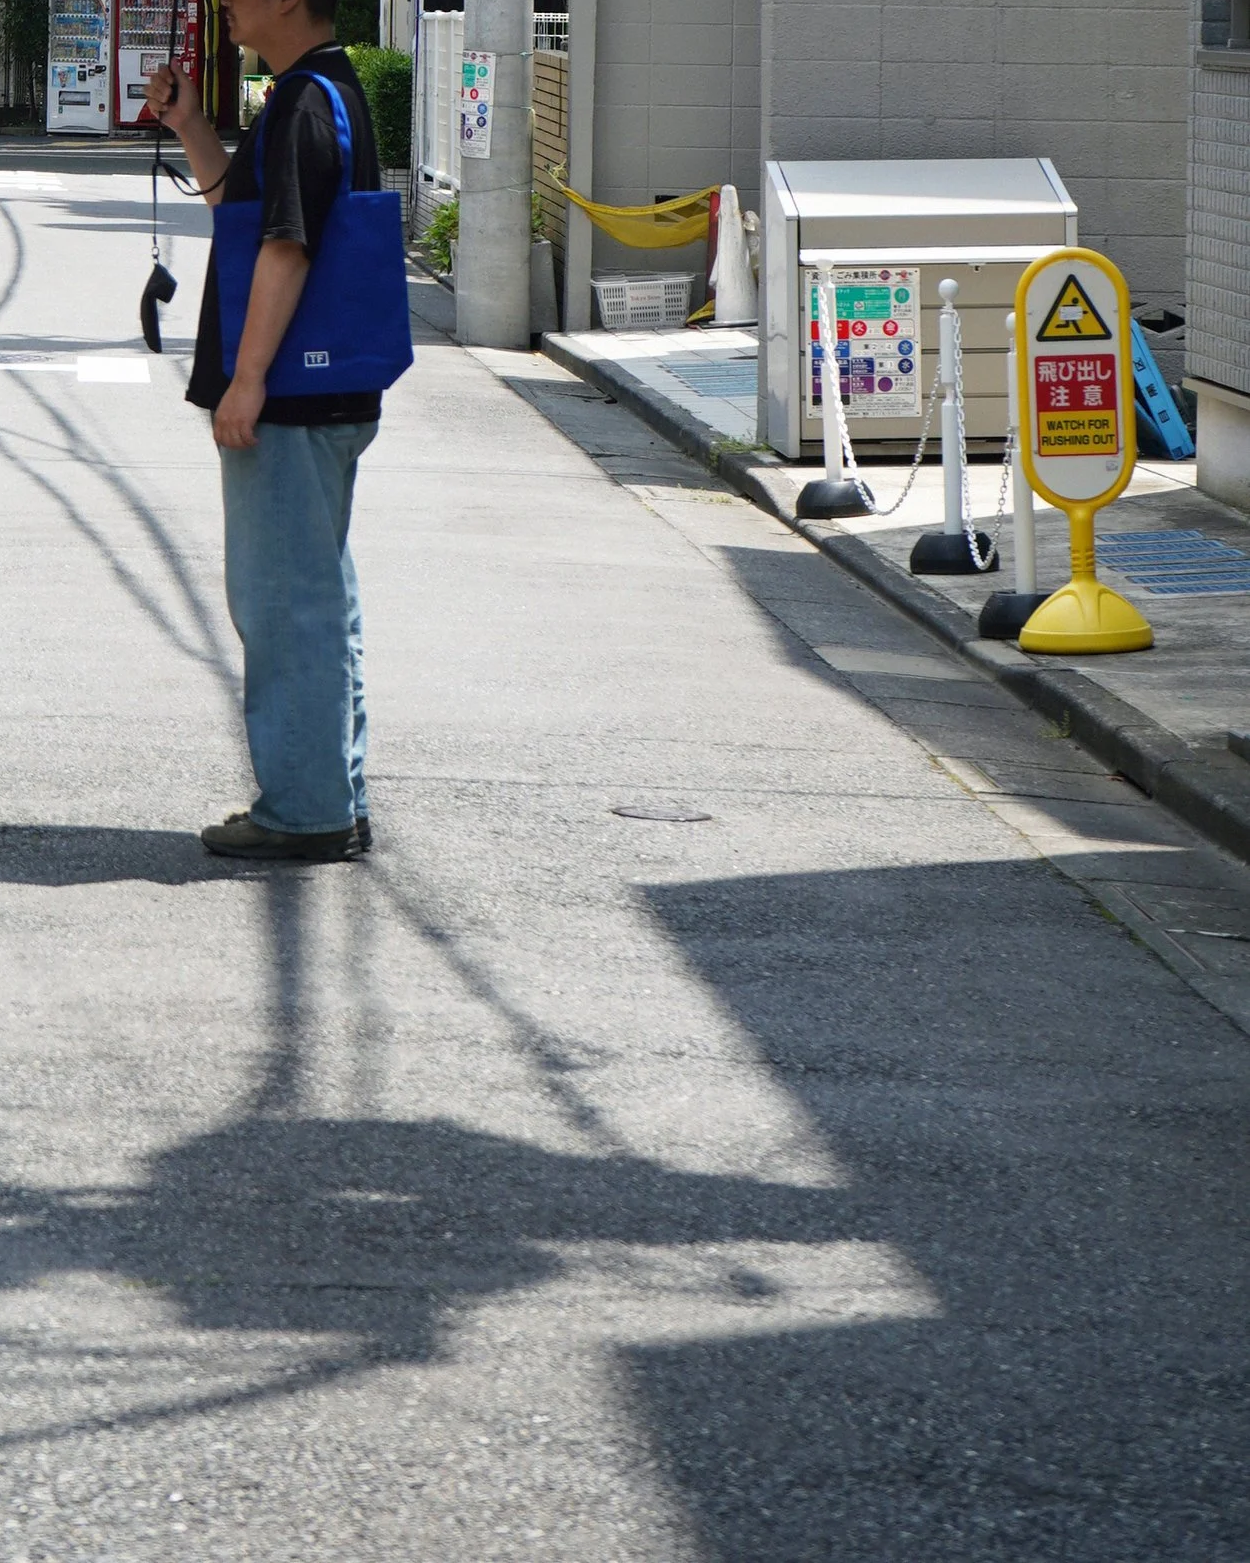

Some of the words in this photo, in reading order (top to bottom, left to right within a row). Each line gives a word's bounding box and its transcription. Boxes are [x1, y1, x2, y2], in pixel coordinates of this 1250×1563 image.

[309, 354, 324, 363] TF
[1038, 360, 1111, 382] 飛び出し
[1050, 385, 1103, 406] 注意
[1046, 420, 1085, 430] WATCH
[1088, 419, 1109, 429] FOR
[1041, 435, 1090, 446] RUSHING
[1092, 434, 1115, 445] OUT
